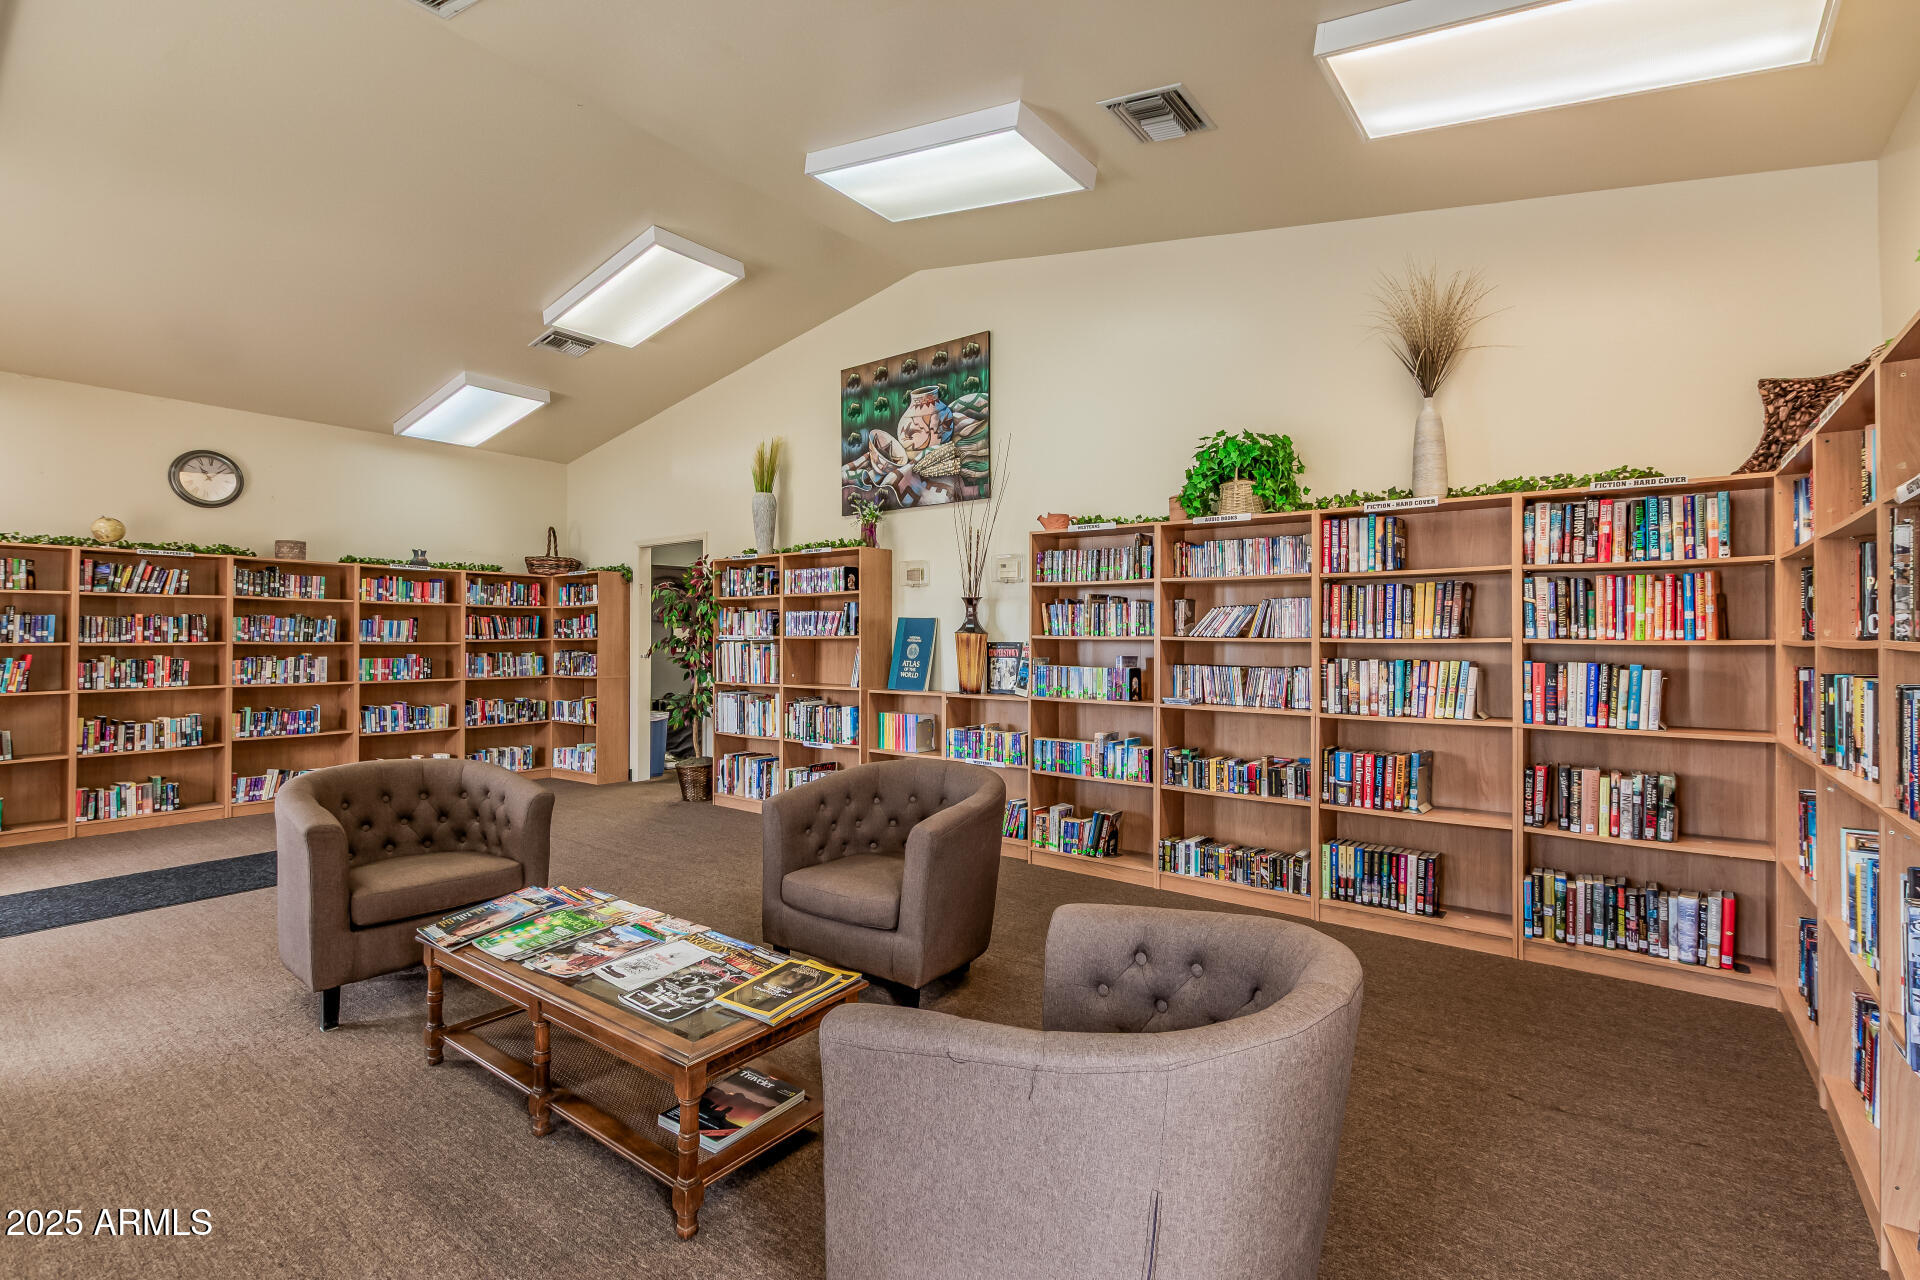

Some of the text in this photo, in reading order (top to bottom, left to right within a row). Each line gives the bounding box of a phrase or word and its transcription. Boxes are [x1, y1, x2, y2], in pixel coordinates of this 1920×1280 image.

[1595, 480, 1627, 489] FICTION
[1634, 478, 1656, 486] HARD
[1659, 476, 1687, 485] COVER
[1366, 502, 1391, 510] FICTION
[1396, 500, 1413, 508] HARD
[1415, 498, 1436, 506] COVER
[1220, 514, 1238, 522] BOOKS
[1574, 507, 1585, 538] AUTOPSY
[1649, 498, 1658, 550] ROBERT CRAIS
[902, 660, 921, 669] ATLAS
[900, 671, 919, 679] WORLD
[1525, 777, 1533, 816] ZERO DAY
[1699, 910, 1708, 937] jar city
[739, 1069, 775, 1090] Traveler
